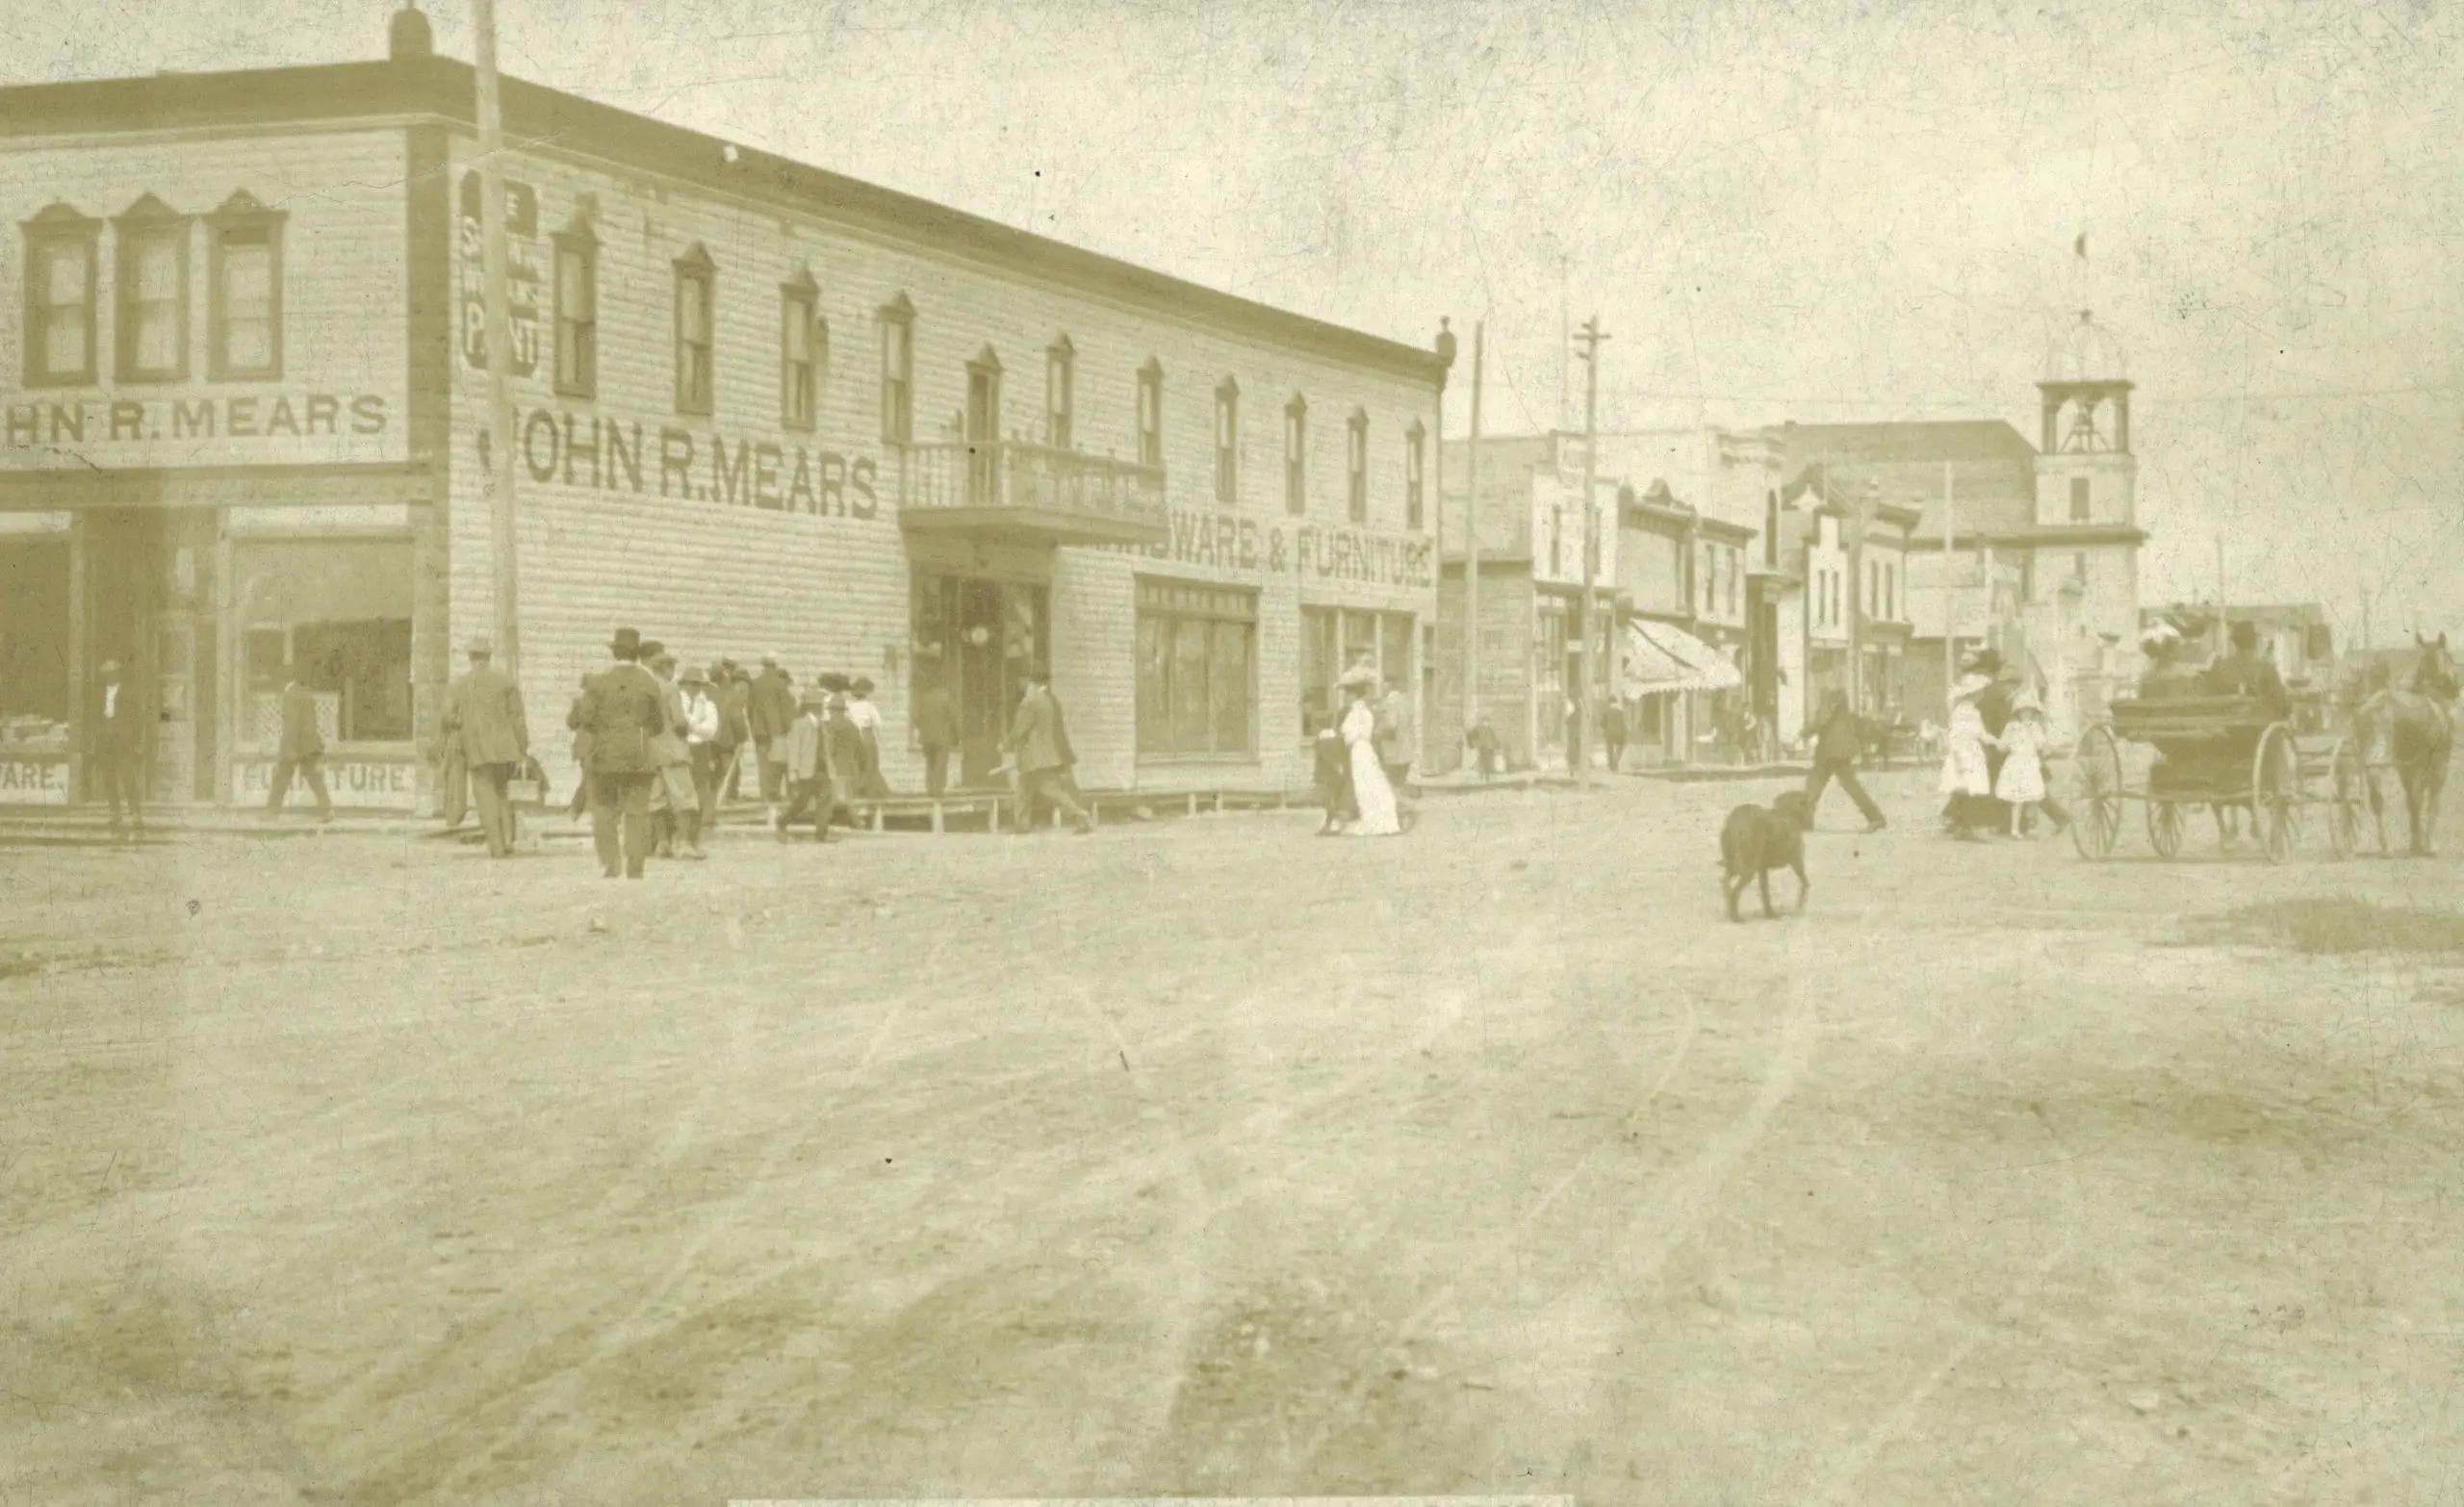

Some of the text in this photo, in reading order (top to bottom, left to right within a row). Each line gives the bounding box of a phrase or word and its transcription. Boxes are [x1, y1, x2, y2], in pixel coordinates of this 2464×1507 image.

[171, 394, 388, 439] MEARS
[707, 433, 878, 521] MEARS
[1269, 526, 1287, 573] &
[244, 762, 405, 791] FUTURE
